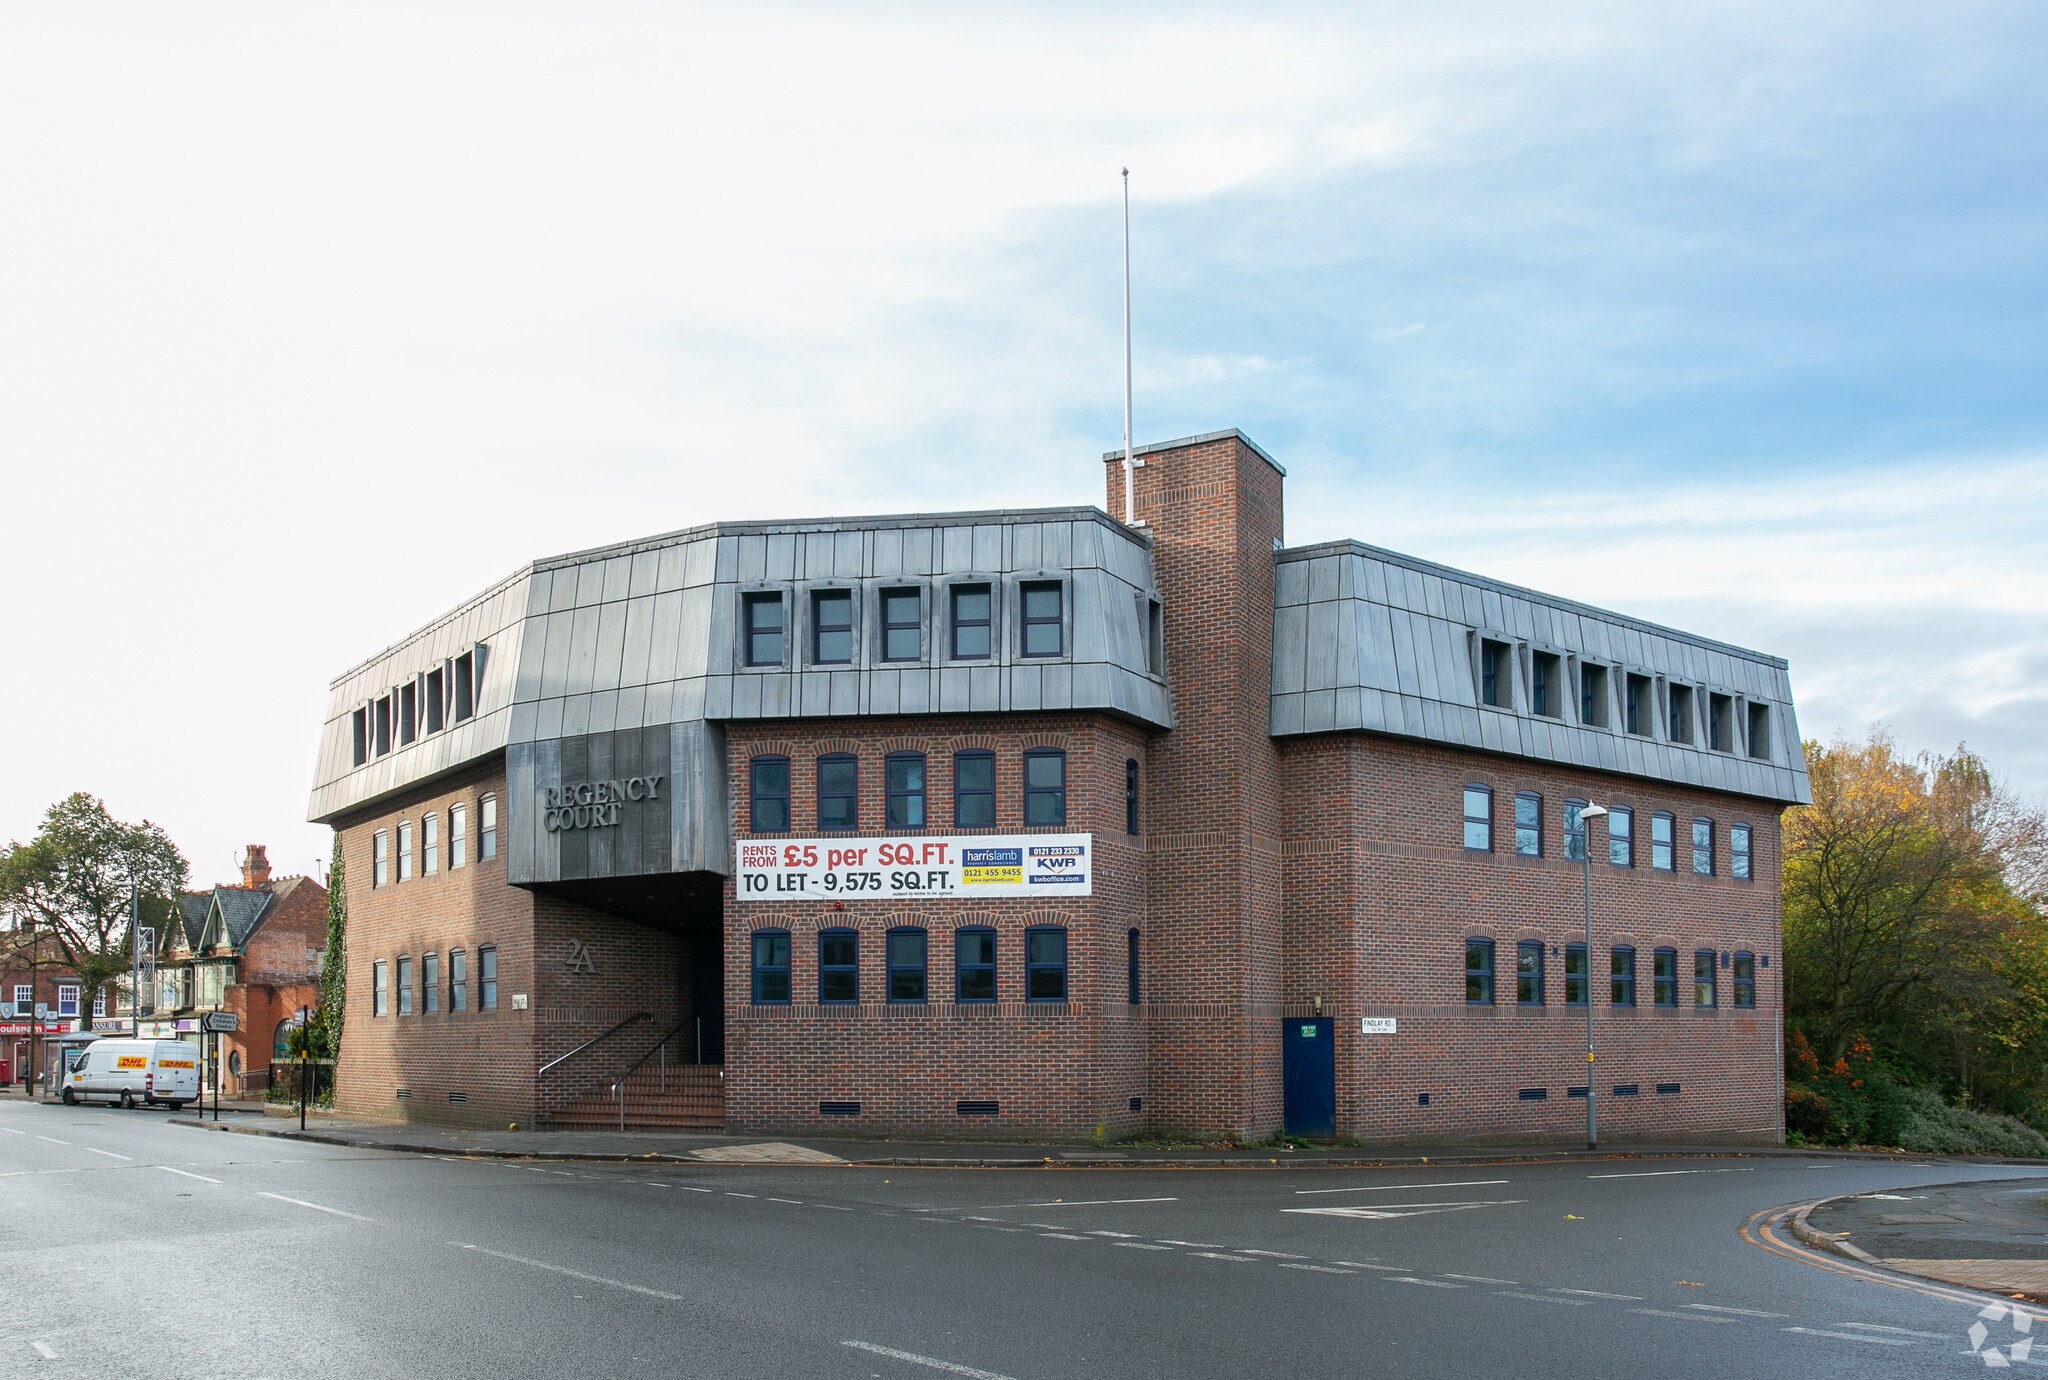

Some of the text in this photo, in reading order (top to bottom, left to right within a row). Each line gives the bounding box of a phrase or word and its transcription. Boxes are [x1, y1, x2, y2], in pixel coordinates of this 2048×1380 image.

[543, 775, 662, 808] REGENCY
[543, 802, 622, 832] COURT
[742, 845, 777, 856] RENTS
[967, 849, 1018, 861] harrislamb
[1033, 847, 1049, 855] 0121
[1050, 847, 1062, 855] 233
[742, 856, 777, 867] FROM
[783, 843, 954, 871] £5 per SQ.FT.
[1037, 857, 1076, 869] KWB
[964, 868, 1021, 877] 0121 455 9455
[743, 873, 769, 892] TO
[776, 873, 808, 892] LET
[823, 872, 882, 893] 9,575
[890, 871, 954, 890] SQ.FT.
[565, 938, 597, 974] 2A
[121, 1058, 142, 1067] DHL
[164, 1060, 190, 1068] DHL
